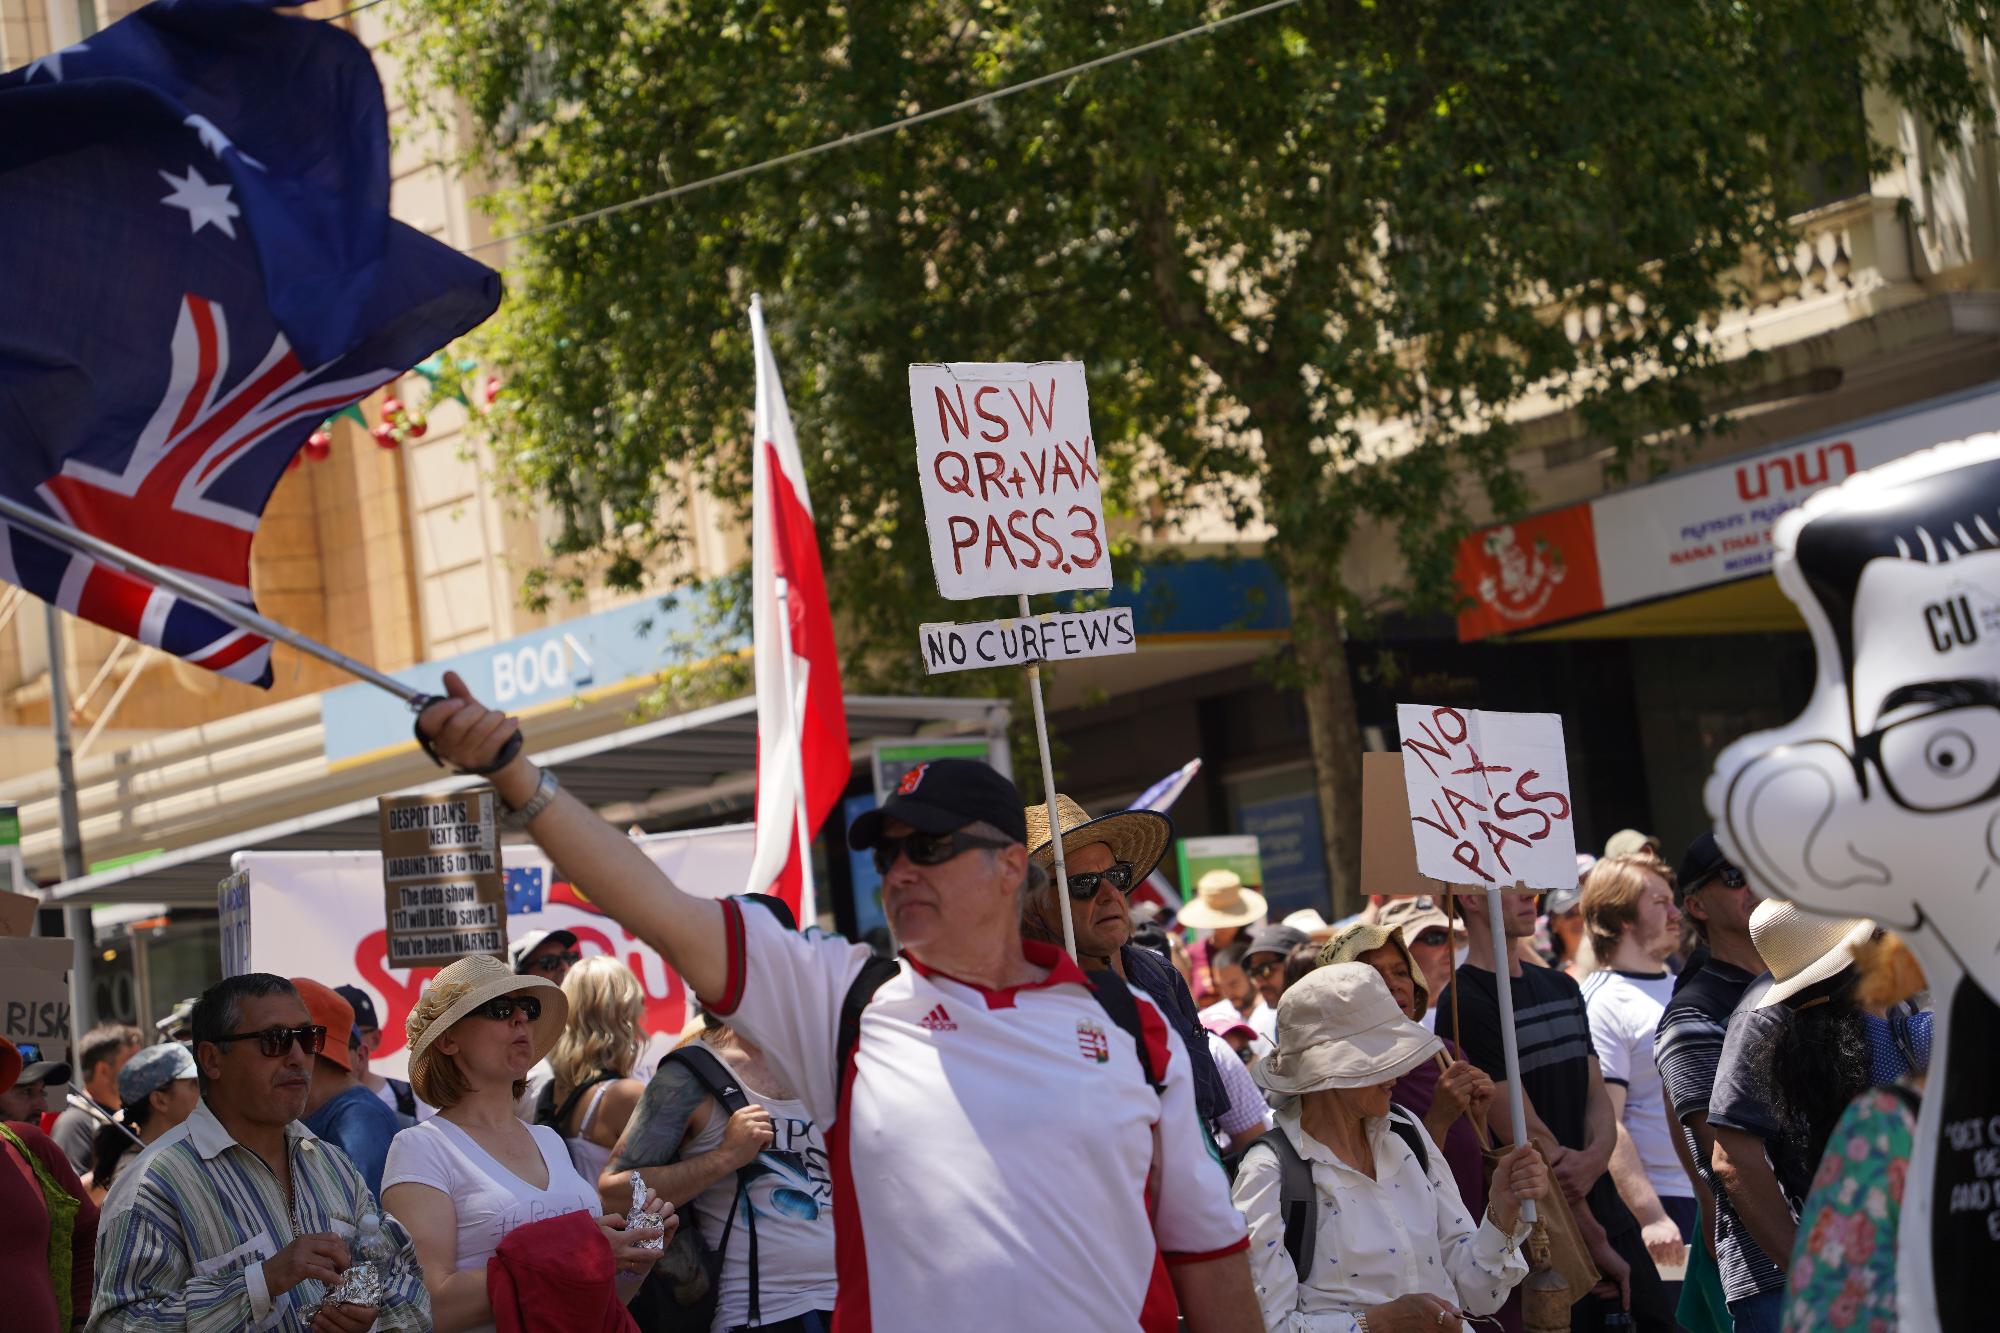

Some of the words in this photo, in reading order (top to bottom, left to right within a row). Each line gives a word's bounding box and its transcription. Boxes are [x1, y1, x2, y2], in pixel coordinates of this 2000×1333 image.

[935, 378, 1056, 443] NSW
[927, 630, 967, 668] NO
[976, 612, 1134, 663] CURFEWS
[493, 639, 568, 702] BOQ
[1402, 706, 1467, 778] NO
[1412, 743, 1512, 840] VAX
[390, 807, 430, 830] DESPOT
[433, 803, 467, 824] DAN'S
[430, 827, 452, 845] NEXT
[455, 825, 482, 843] STEP:
[1452, 769, 1570, 882] PASS
[389, 858, 426, 877] JABBING
[427, 857, 444, 874] THE
[447, 855, 453, 872] 5
[456, 855, 466, 872] to
[402, 889, 419, 906] The
[421, 887, 443, 904] data
[446, 885, 474, 901] show
[408, 910, 427, 927] will
[429, 909, 444, 927] DIE
[446, 910, 457, 926] to
[460, 910, 486, 925] save
[393, 936, 424, 956] You've
[425, 936, 451, 954] been
